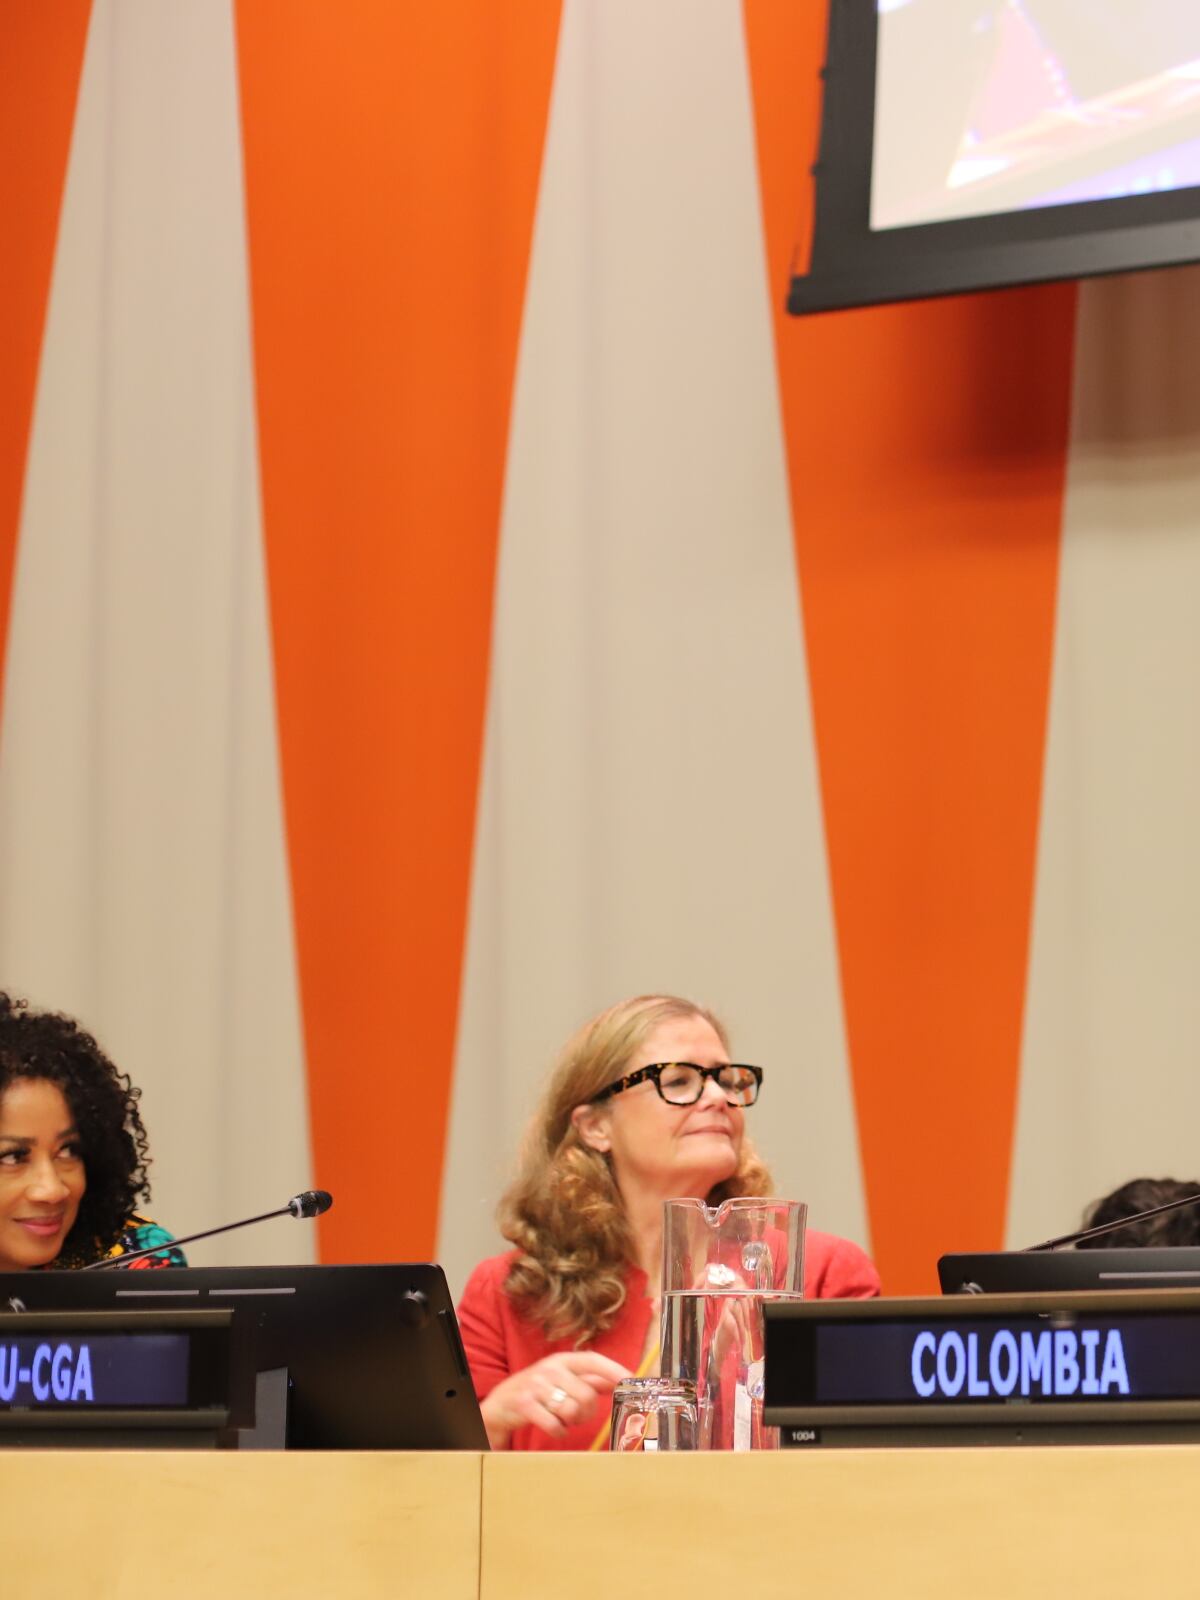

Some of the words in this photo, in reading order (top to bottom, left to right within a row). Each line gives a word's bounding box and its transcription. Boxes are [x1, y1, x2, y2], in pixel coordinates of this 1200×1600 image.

[0, 1343, 94, 1401] U-CGA
[911, 1329, 1130, 1397] COLOMBIA
[791, 1430, 815, 1441] 1004
